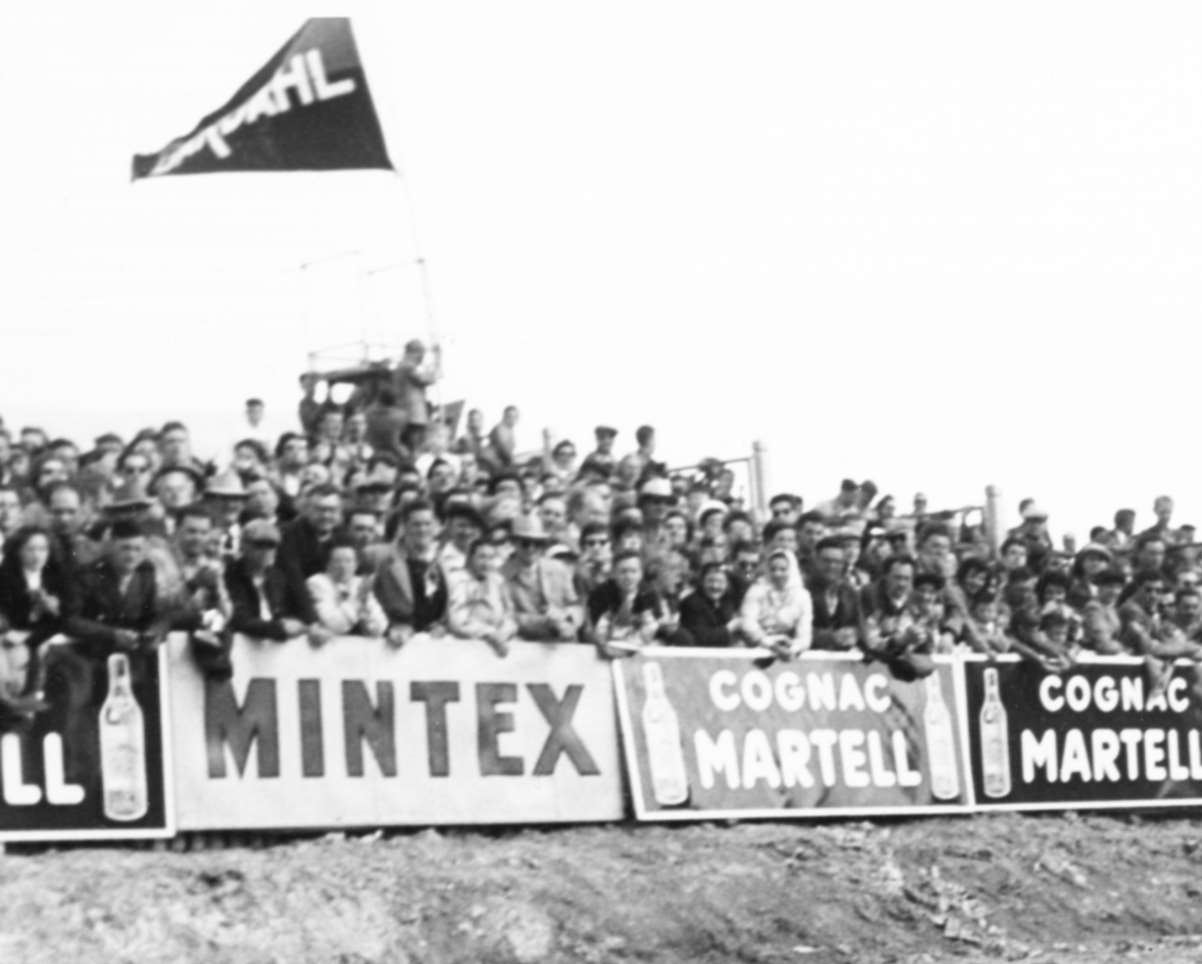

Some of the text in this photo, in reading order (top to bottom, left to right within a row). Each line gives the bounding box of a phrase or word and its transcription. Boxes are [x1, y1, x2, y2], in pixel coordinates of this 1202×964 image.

[709, 668, 893, 713] COGNAC
[1039, 674, 1190, 712] COGNAC
[205, 677, 601, 779] MINTEX
[694, 728, 922, 790] MARTELL
